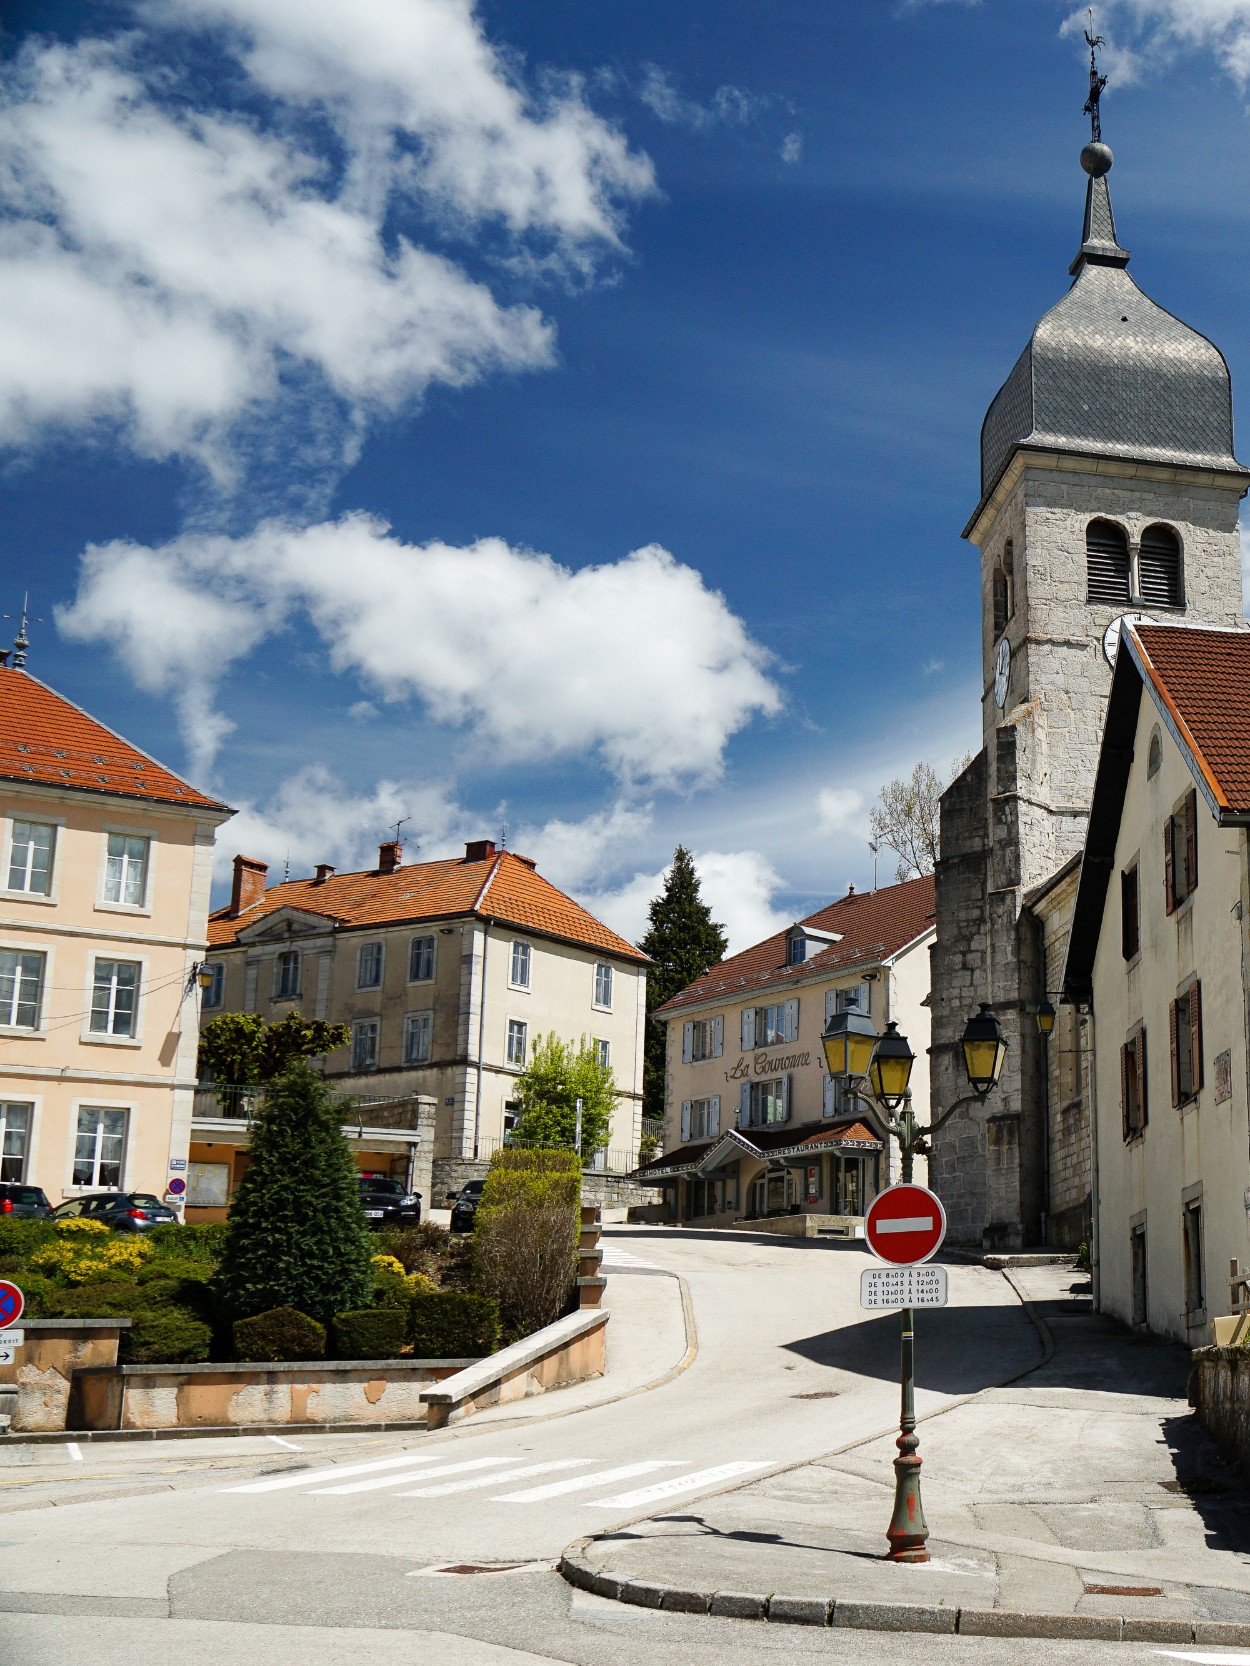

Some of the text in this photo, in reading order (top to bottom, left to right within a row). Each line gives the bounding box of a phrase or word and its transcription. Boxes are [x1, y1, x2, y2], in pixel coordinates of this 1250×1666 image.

[729, 1052, 812, 1079] La Couronne
[777, 1142, 823, 1156] RESTAURANT
